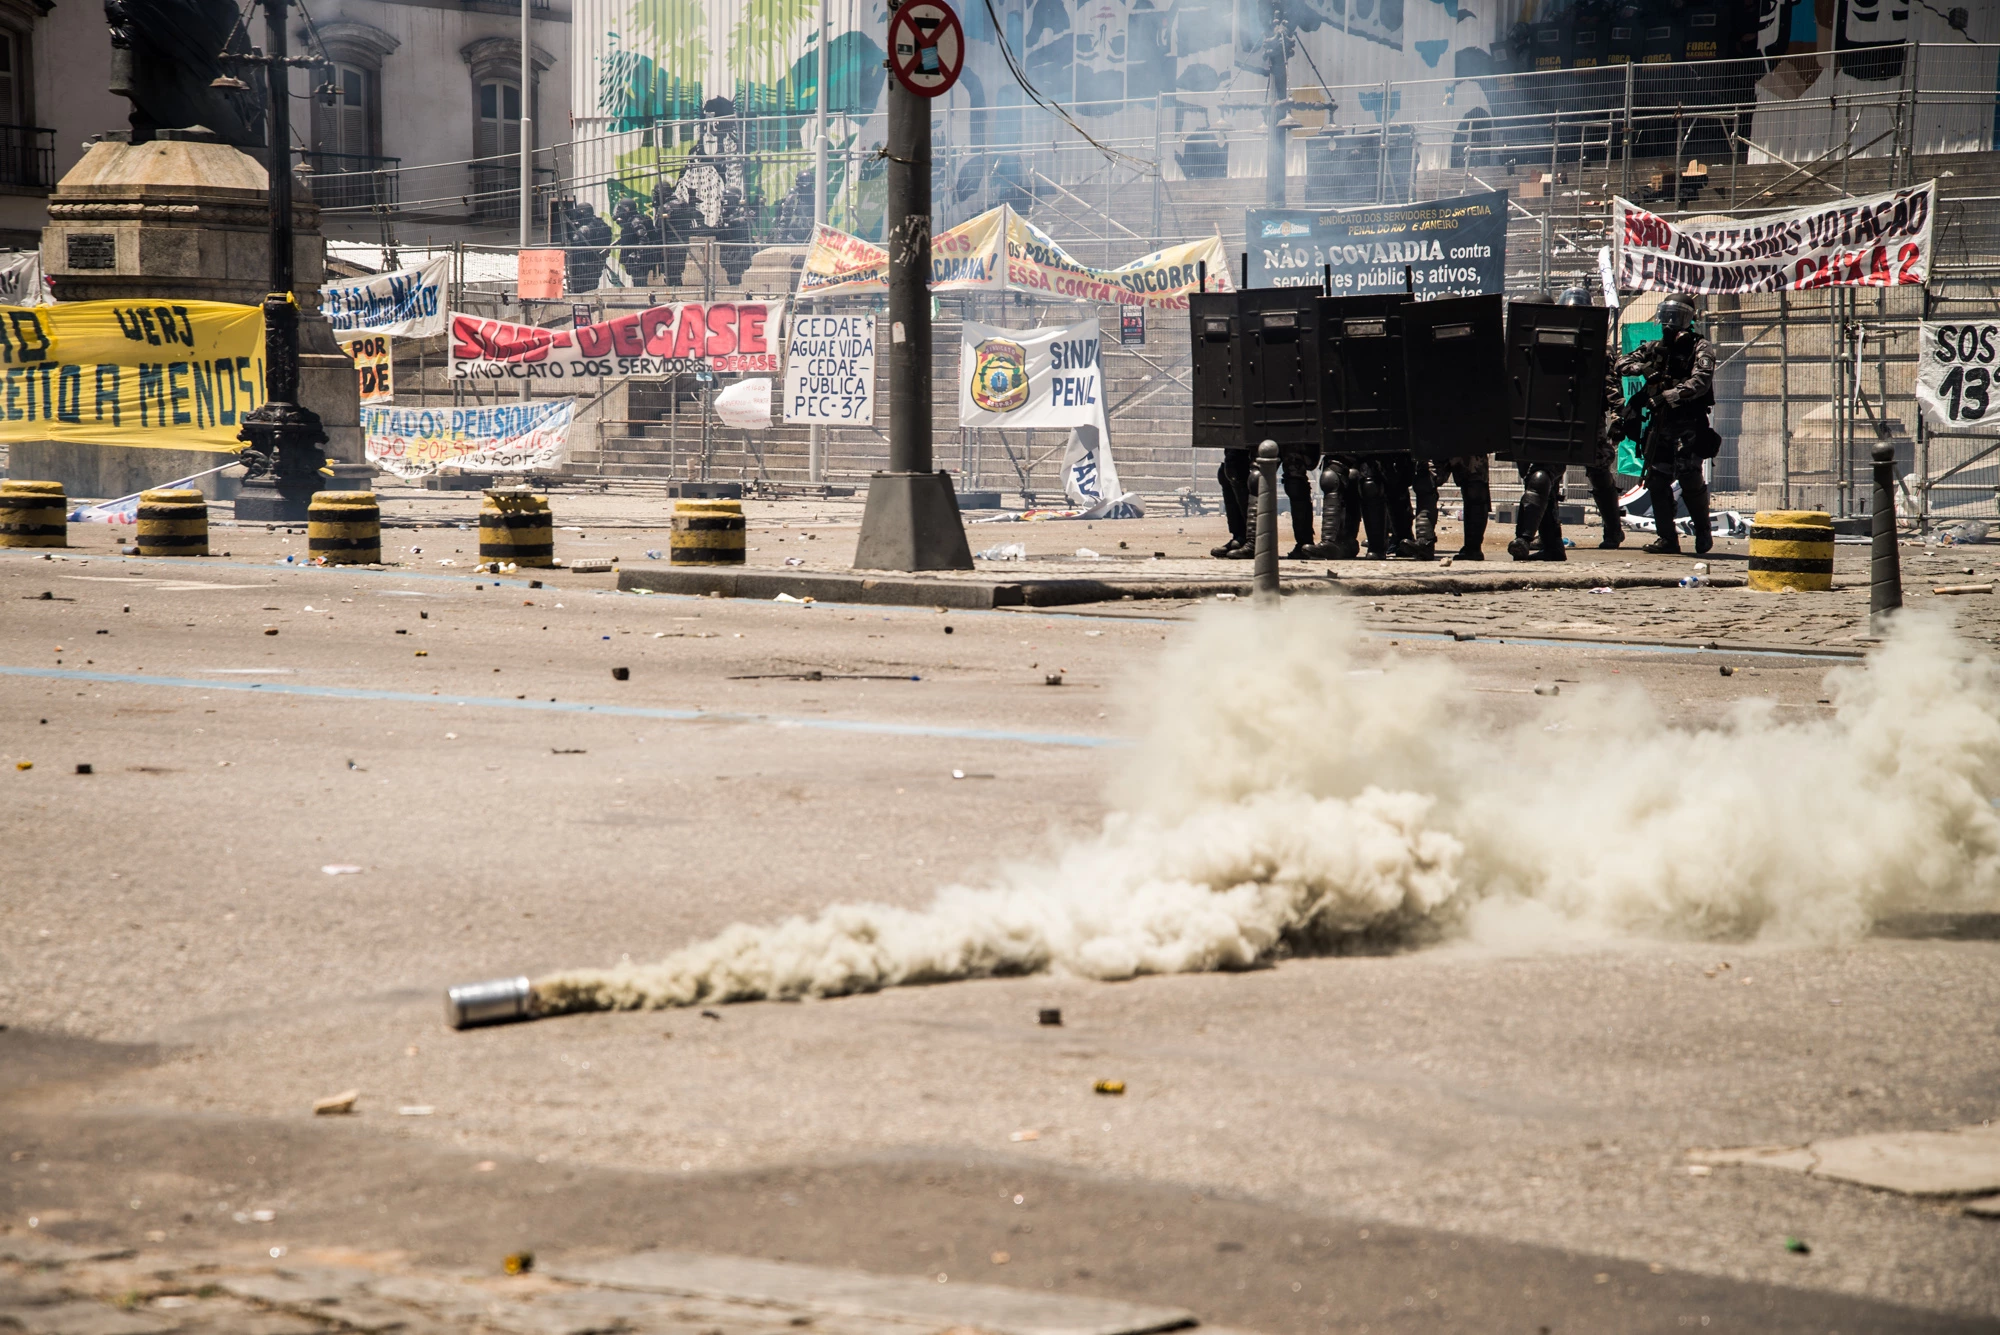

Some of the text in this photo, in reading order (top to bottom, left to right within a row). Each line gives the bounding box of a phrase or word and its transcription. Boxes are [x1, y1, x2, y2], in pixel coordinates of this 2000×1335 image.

[1319, 205, 1491, 226] SINDICATO DOS SERVIDORES DO SISTEMA
[1348, 224, 1376, 236] PENAL
[1377, 224, 1390, 234] DO
[1391, 223, 1406, 232] RIO
[1420, 219, 1459, 231] JANEIRO
[1675, 220, 1802, 262] ACEITAMOS
[1806, 189, 1929, 249] VOTAÇÃO
[817, 227, 848, 252] SEM
[1008, 241, 1021, 259] OS
[931, 253, 998, 281] CABANA!
[1263, 239, 1491, 269] NÃO à COVARDIA contra
[1794, 246, 1891, 290] CAIXA
[1898, 242, 1923, 285] 2
[1009, 264, 1051, 291] ESSA
[1056, 276, 1111, 302] CONTA
[1429, 264, 1481, 284] ativos,
[113, 305, 194, 347] UERJ
[797, 317, 862, 338] CEDAE
[352, 336, 386, 359] POR
[839, 338, 874, 358] VIDA
[1936, 325, 1998, 363] SOS
[361, 363, 390, 393] DE
[455, 360, 565, 379] SINDICATO
[570, 358, 613, 378] DOS
[618, 357, 706, 376] SERVIDORES
[712, 354, 778, 372] DEGASE
[808, 359, 858, 377] CEDAE
[0, 361, 81, 423] EITO
[95, 363, 121, 427] A
[1052, 375, 1096, 406] PENL
